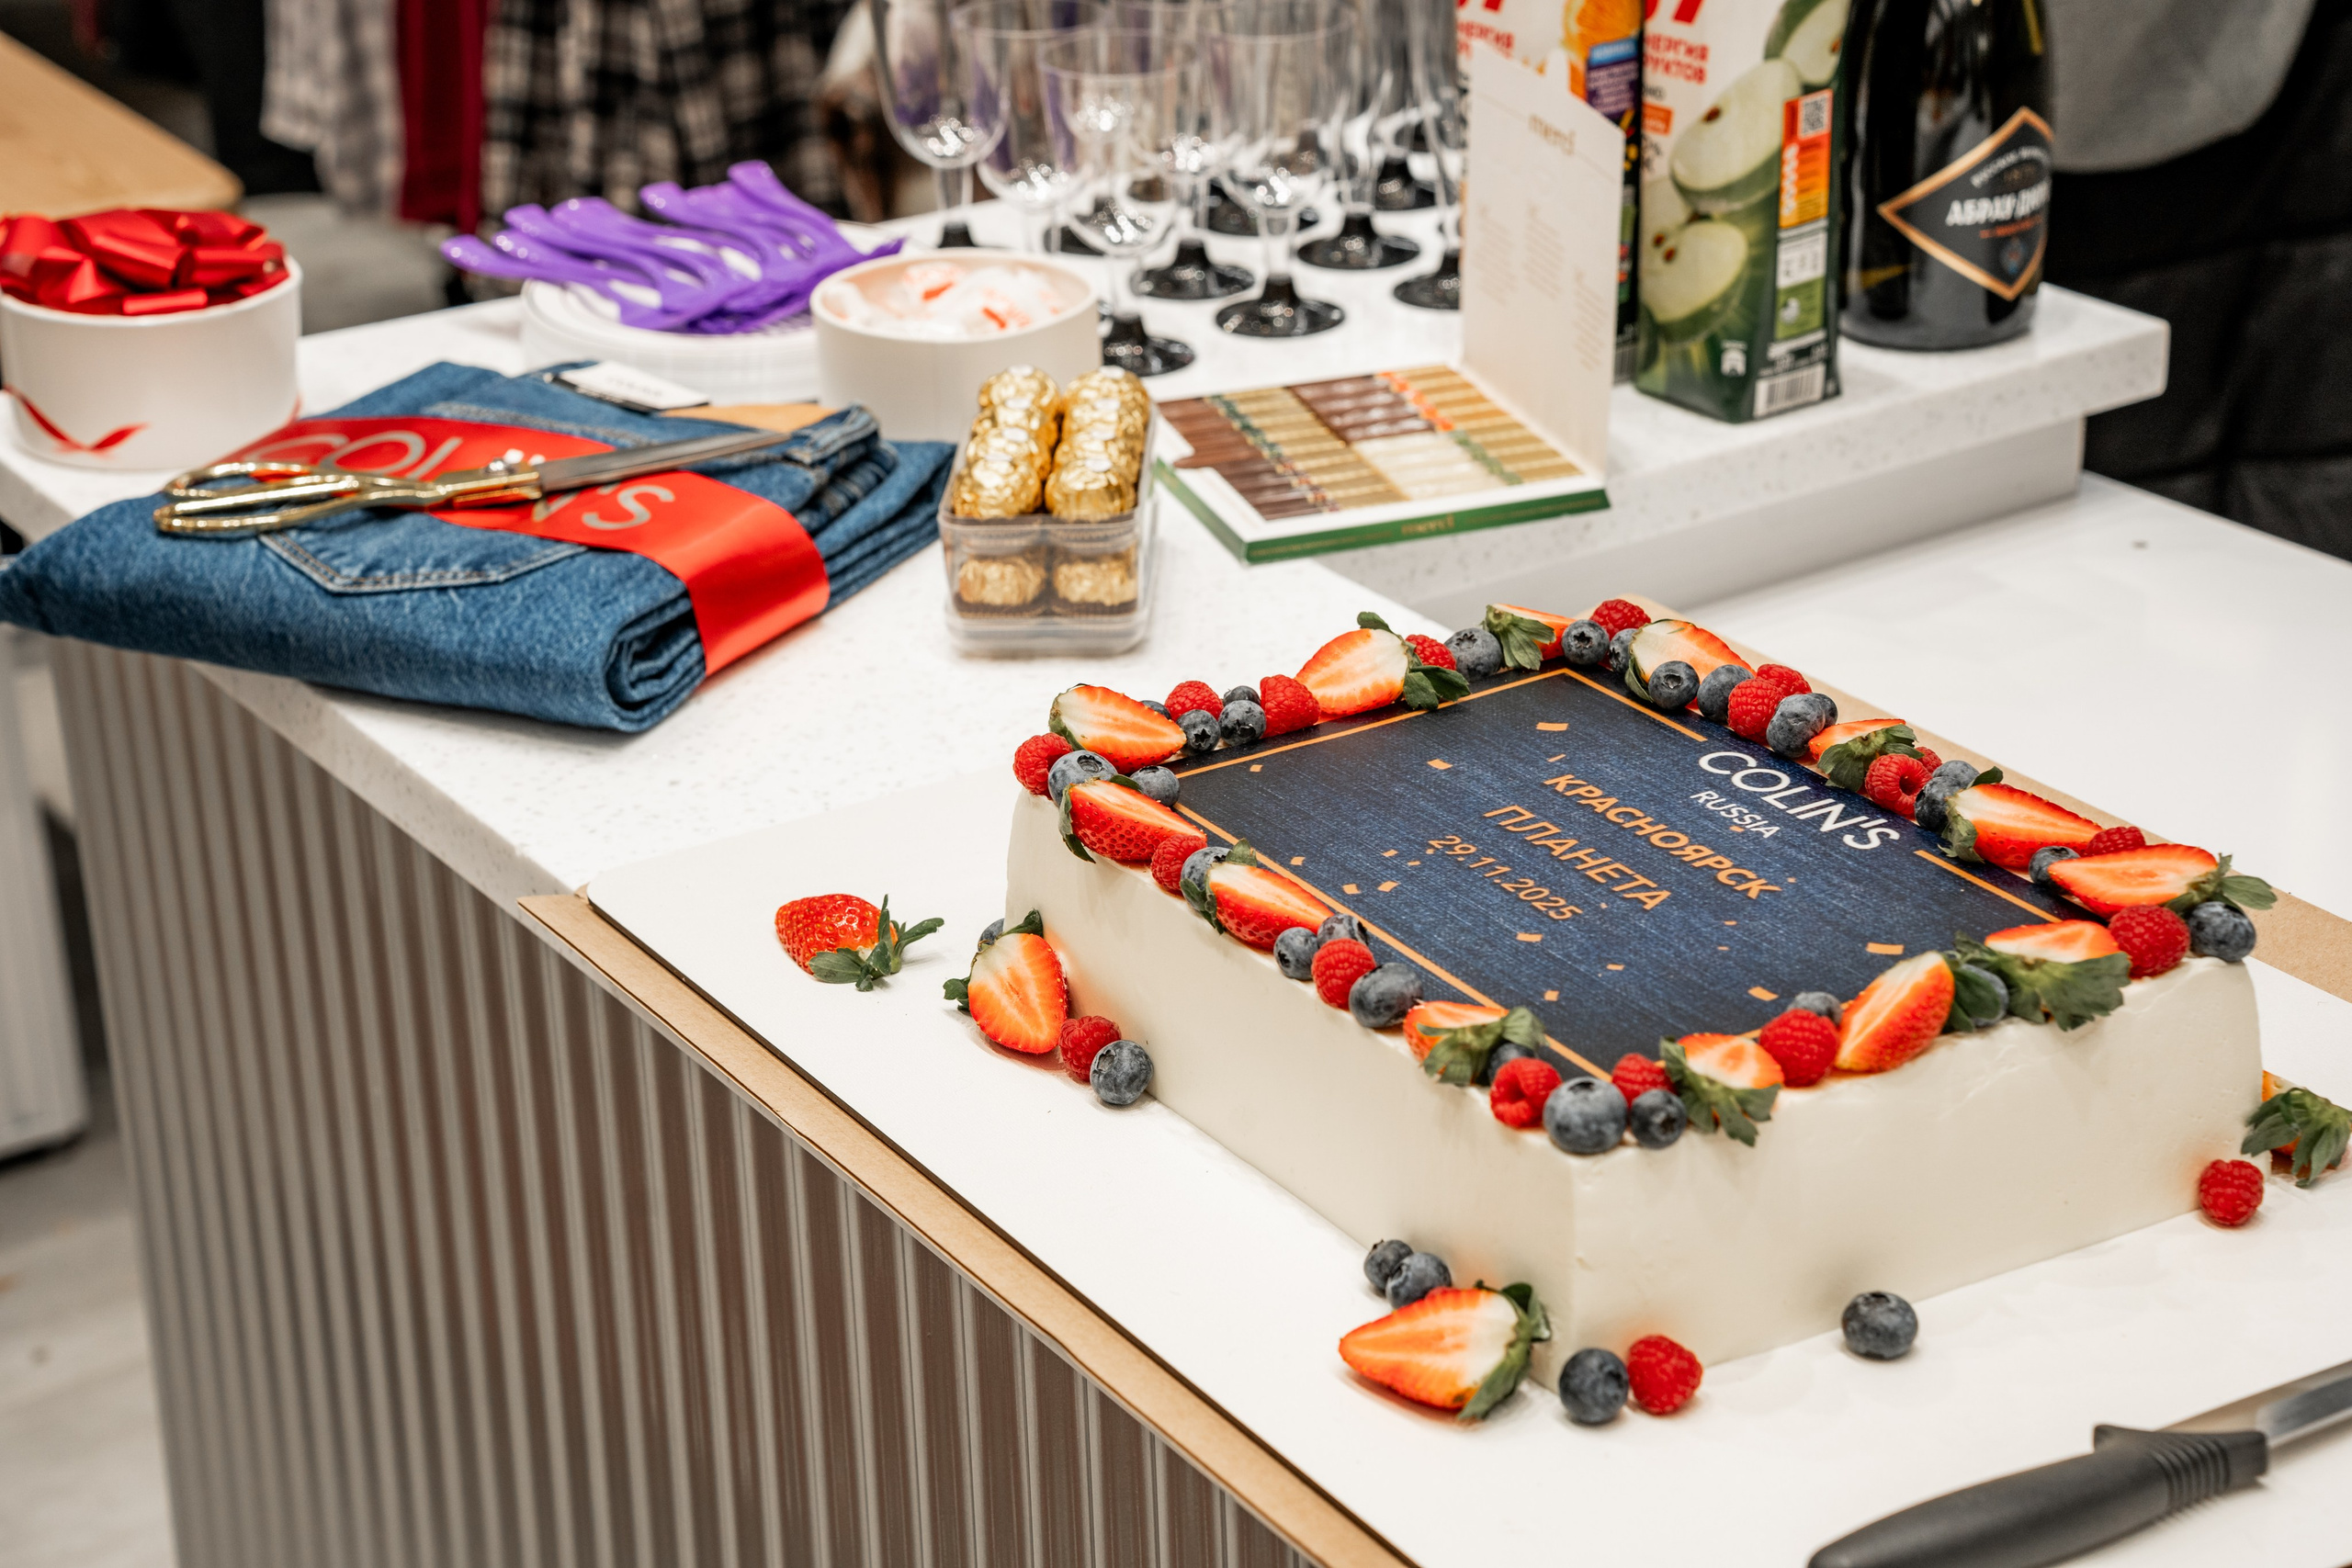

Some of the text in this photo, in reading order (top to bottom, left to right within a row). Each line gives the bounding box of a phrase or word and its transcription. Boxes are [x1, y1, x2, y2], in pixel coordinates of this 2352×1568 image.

[1643, 52, 1707, 85] РУКТОВ
[1644, 34, 1709, 62] НЕРГИЯ
[1544, 773, 1781, 899] КРАСНОЯРСК
[1689, 790, 1781, 840] RUSSIA
[1698, 751, 1901, 851] COLIN'S
[1429, 835, 1583, 920] 29.11.2025
[1484, 805, 1671, 910] ПЛАНЕТА
